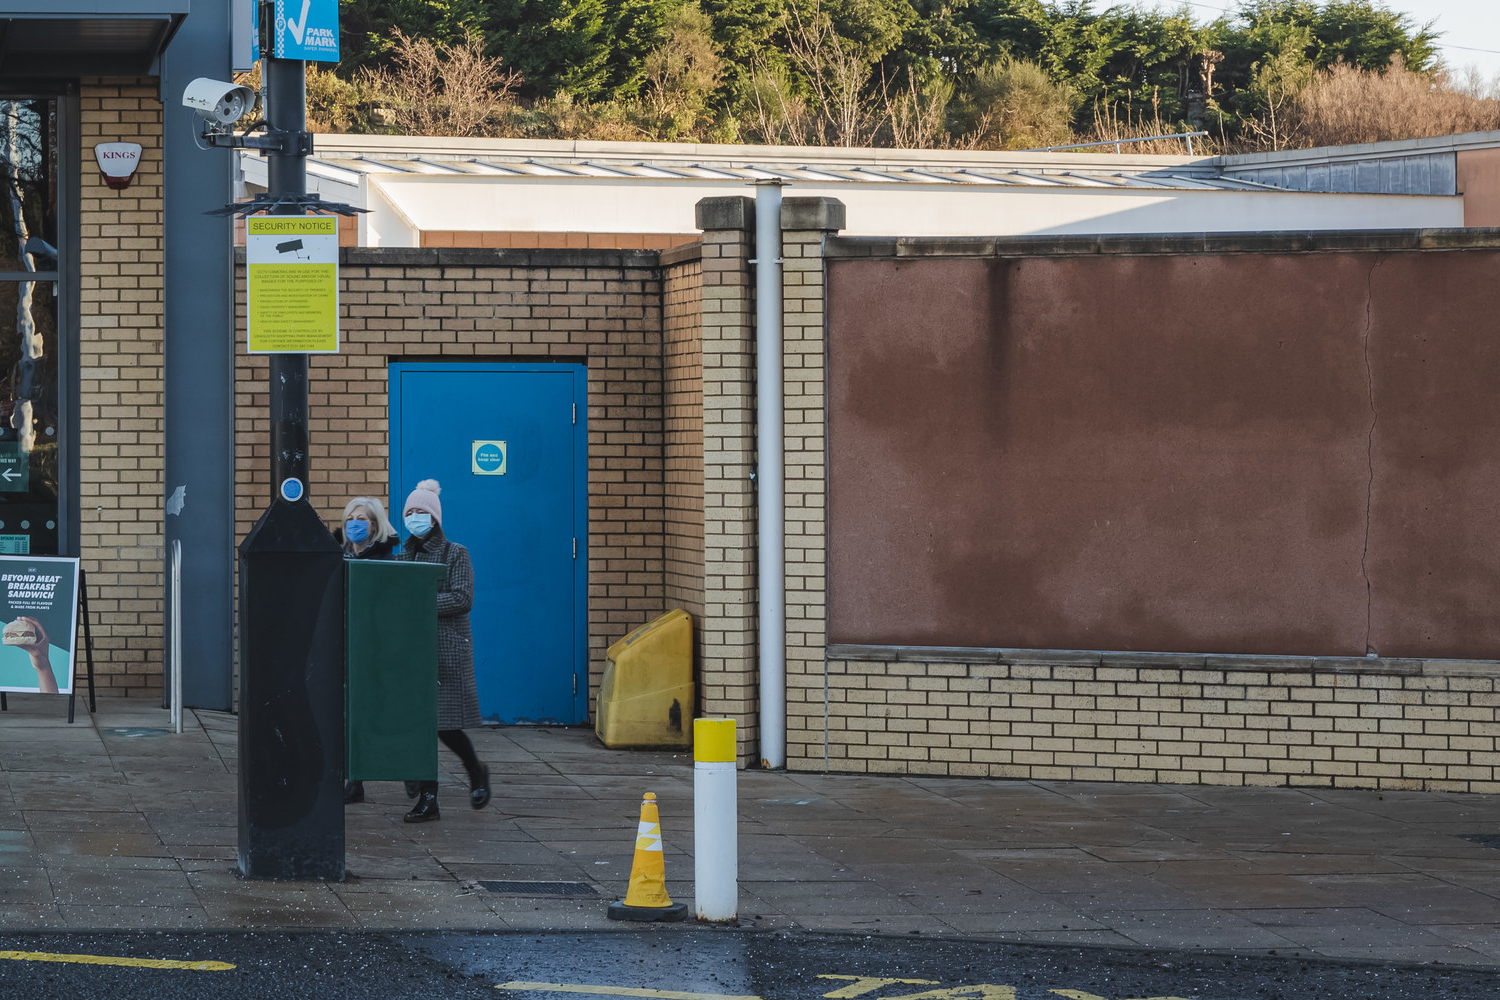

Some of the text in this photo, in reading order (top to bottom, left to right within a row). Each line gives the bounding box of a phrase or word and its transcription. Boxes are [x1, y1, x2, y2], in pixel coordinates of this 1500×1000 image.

[306, 28, 334, 38] PARK
[304, 36, 337, 47] MARK
[7, 591, 54, 599] SANDWICH
